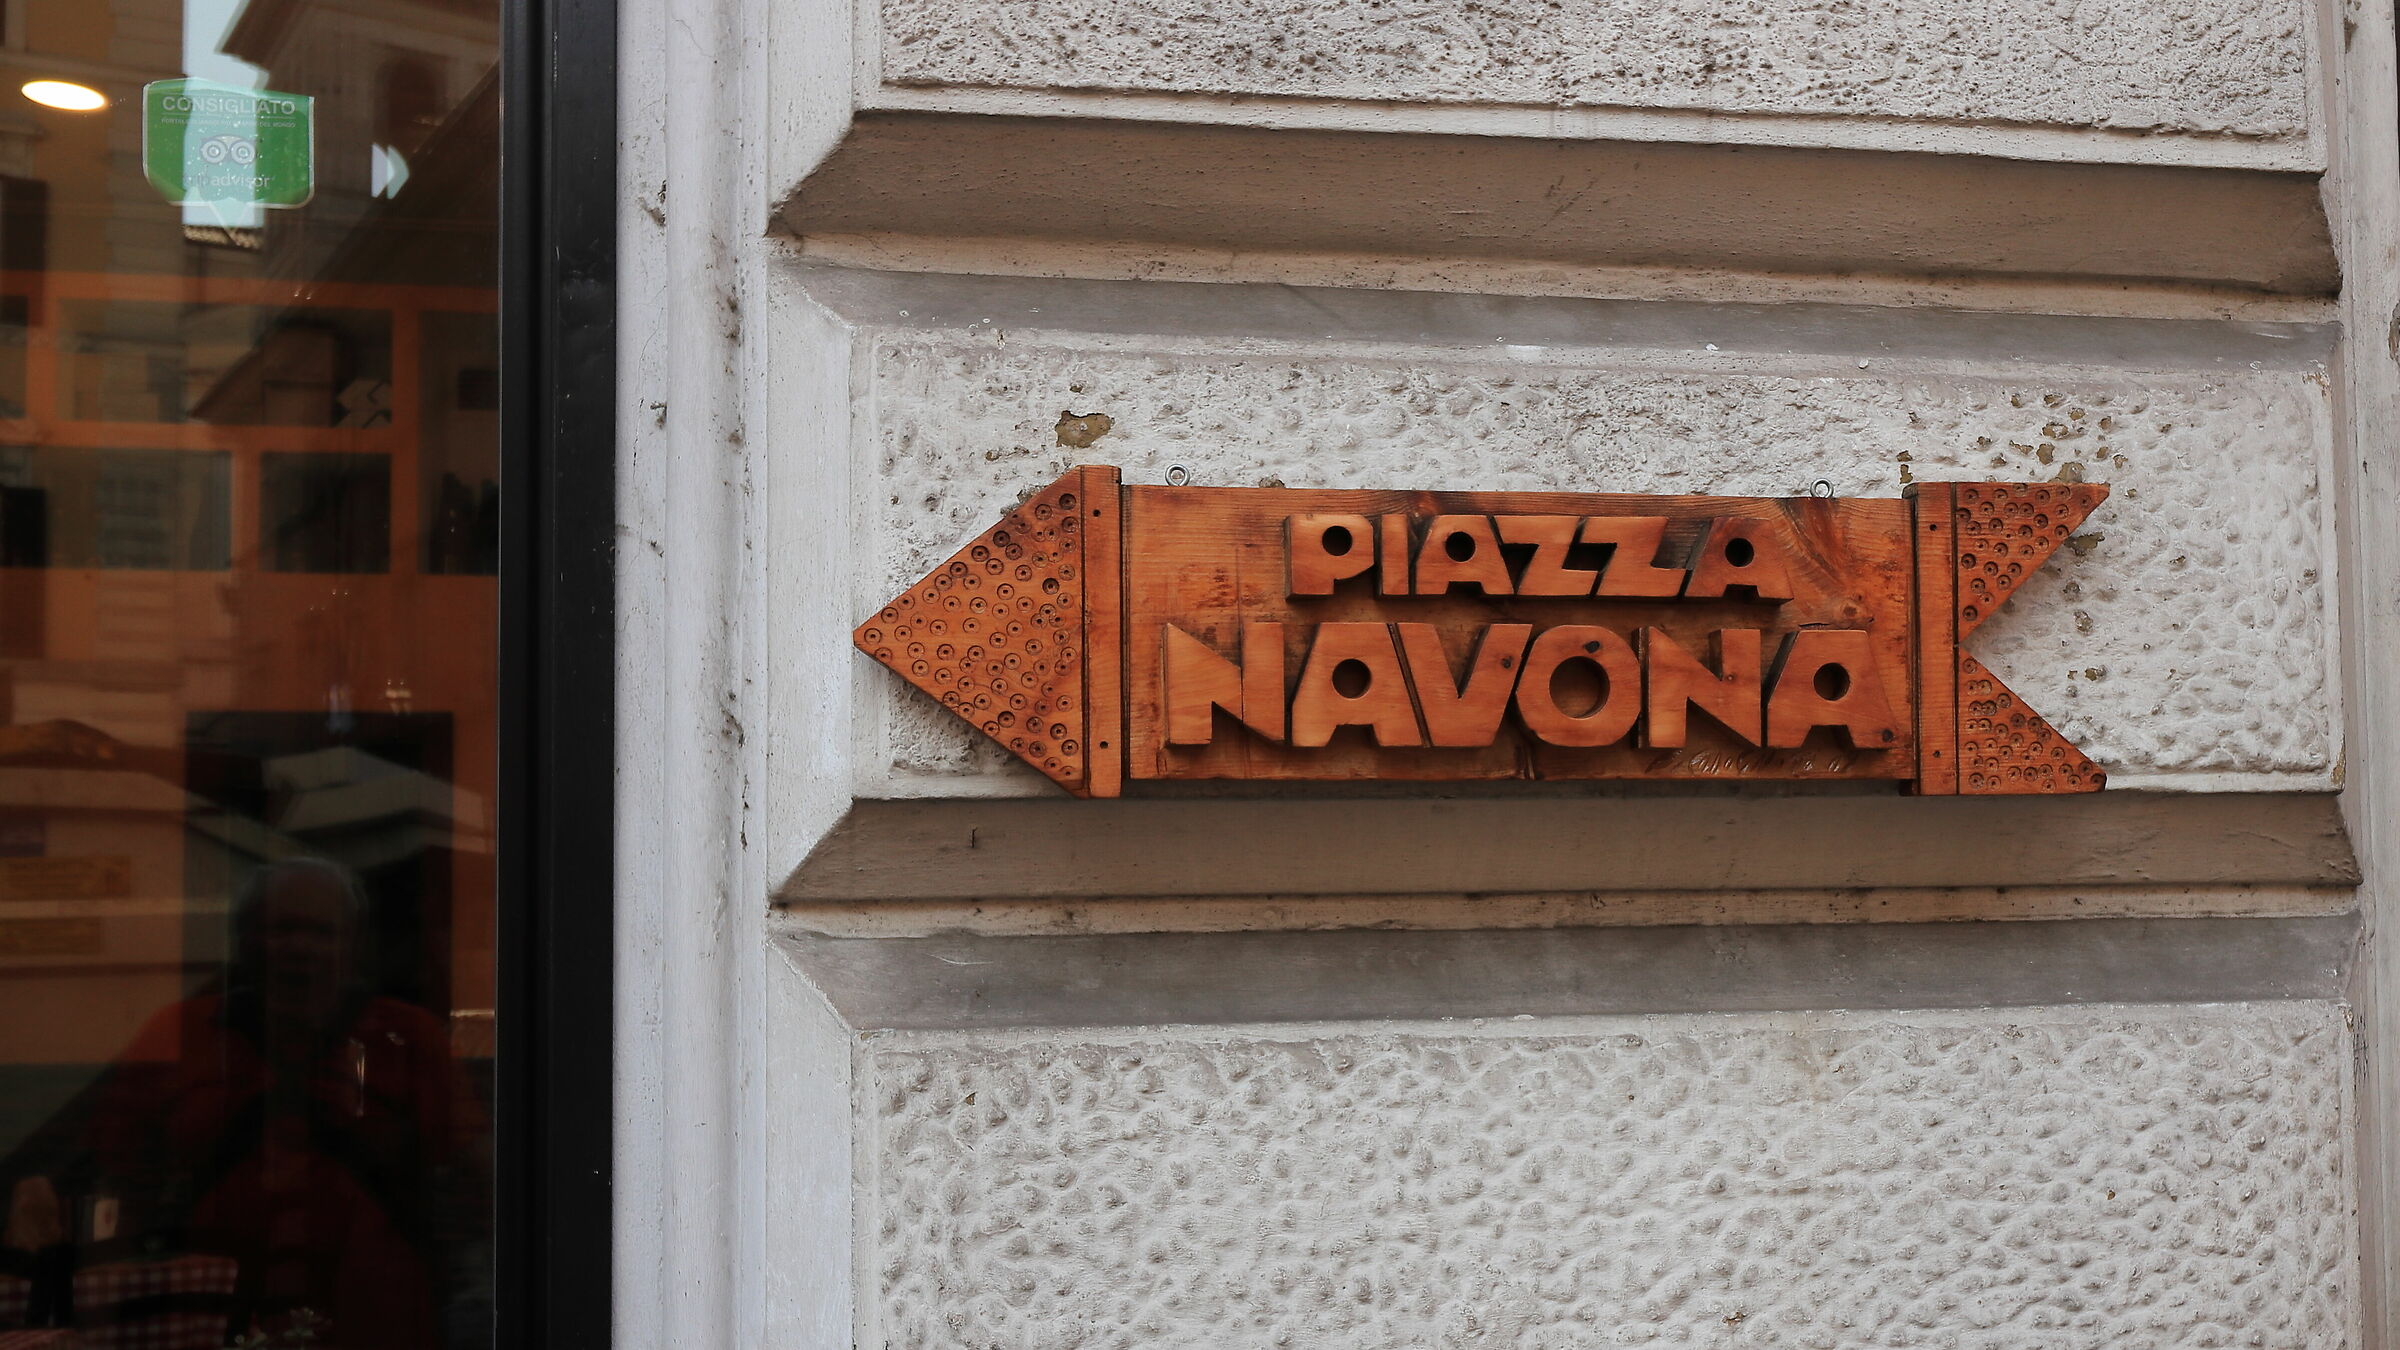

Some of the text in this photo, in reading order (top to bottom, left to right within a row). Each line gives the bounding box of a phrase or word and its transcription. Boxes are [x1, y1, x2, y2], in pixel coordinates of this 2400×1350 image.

[162, 97, 296, 115] CONSIGLIATO
[1286, 514, 1793, 599] PIAZZA
[1163, 621, 1896, 749] NAVONA
